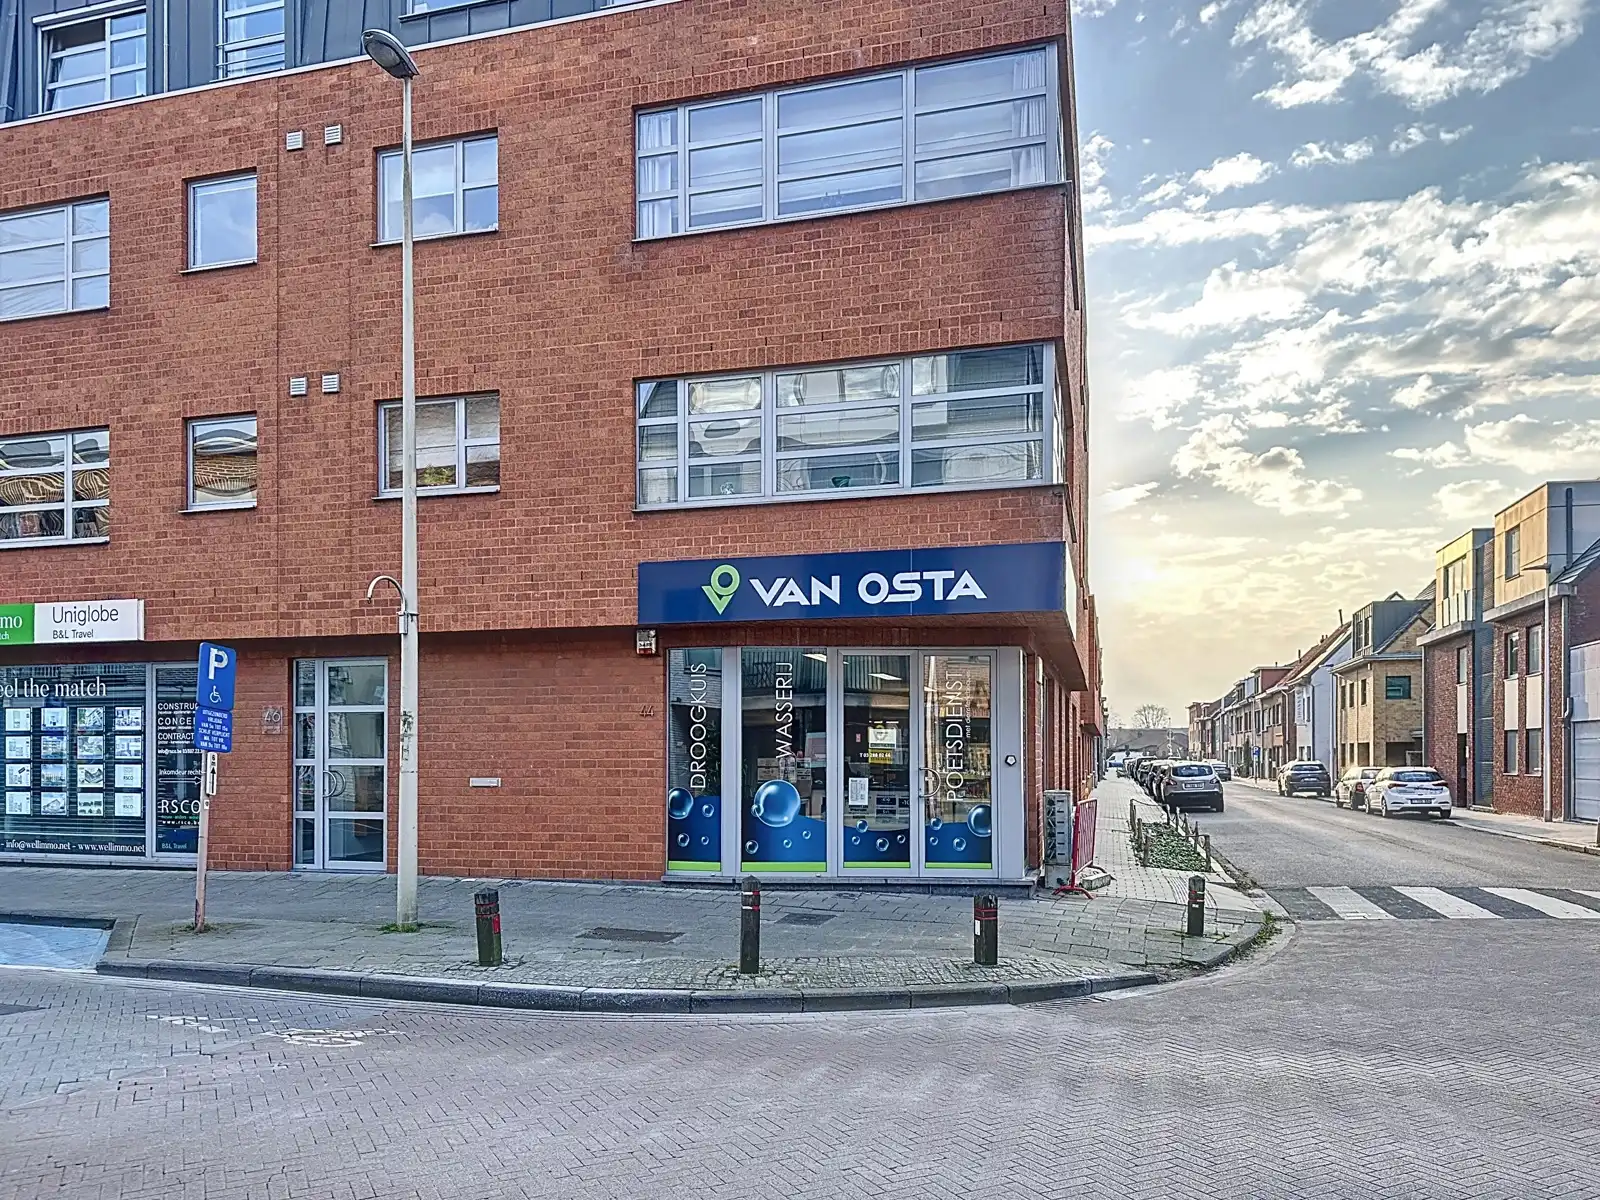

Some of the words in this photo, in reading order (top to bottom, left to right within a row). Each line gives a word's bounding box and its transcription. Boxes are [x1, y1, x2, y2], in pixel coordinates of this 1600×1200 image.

[749, 574, 840, 607] VAN
[858, 569, 988, 604] OSTA
[52, 604, 119, 626] Uniglobe
[52, 629, 69, 639] B&L
[71, 628, 94, 638] Travel
[208, 647, 229, 680] P
[24, 677, 50, 698] the
[55, 675, 107, 697] match
[265, 710, 281, 722] 46
[775, 662, 793, 758] WASSERIJ
[157, 717, 195, 726] CONCE
[690, 663, 707, 788] DROOGKUIS
[945, 670, 964, 802] POETSDIENST
[161, 799, 201, 814] RSCO
[5, 839, 71, 850] info@wellimmo.net
[77, 843, 146, 853] www.wellimmo.net
